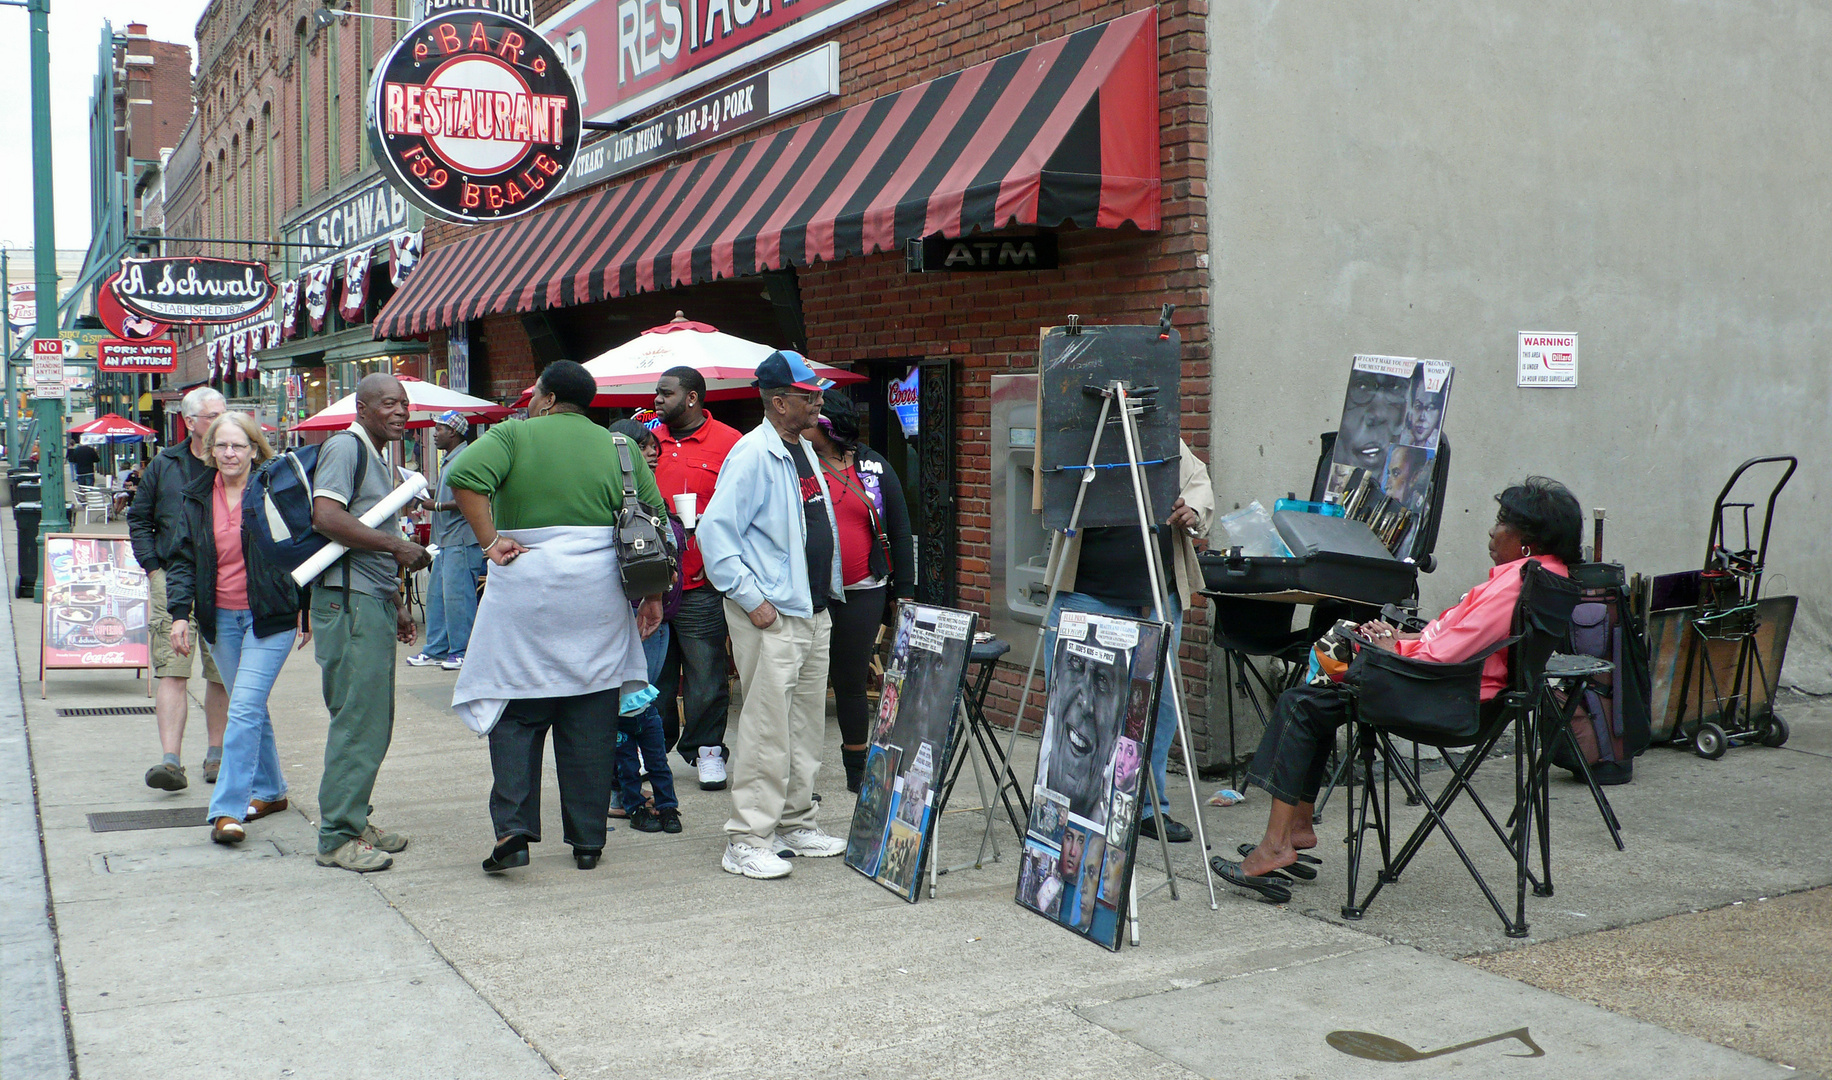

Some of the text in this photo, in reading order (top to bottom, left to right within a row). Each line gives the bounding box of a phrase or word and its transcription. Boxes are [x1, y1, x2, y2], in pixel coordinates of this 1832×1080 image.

[431, 21, 525, 65] BAR
[386, 82, 568, 146] RESTAURANT
[576, 84, 755, 178] STEAKS LIVE MUSIC BAR-B-Q PORK
[400, 143, 560, 209] 159 BEALE
[318, 185, 405, 256] SCHWAB
[944, 241, 1037, 267] ATM
[157, 265, 267, 296] Schwab
[150, 302, 246, 315] ESTABLISHED 1876
[38, 342, 57, 352] NO
[1524, 337, 1574, 347] WARNING!
[104, 346, 138, 354] PORK
[105, 356, 120, 366] AN
[1549, 375, 1575, 383] SURVEILLANCE
[81, 651, 125, 664] Coca-Cola
[1086, 647, 1095, 656] KIDS
[1103, 652, 1114, 661] PRICE
